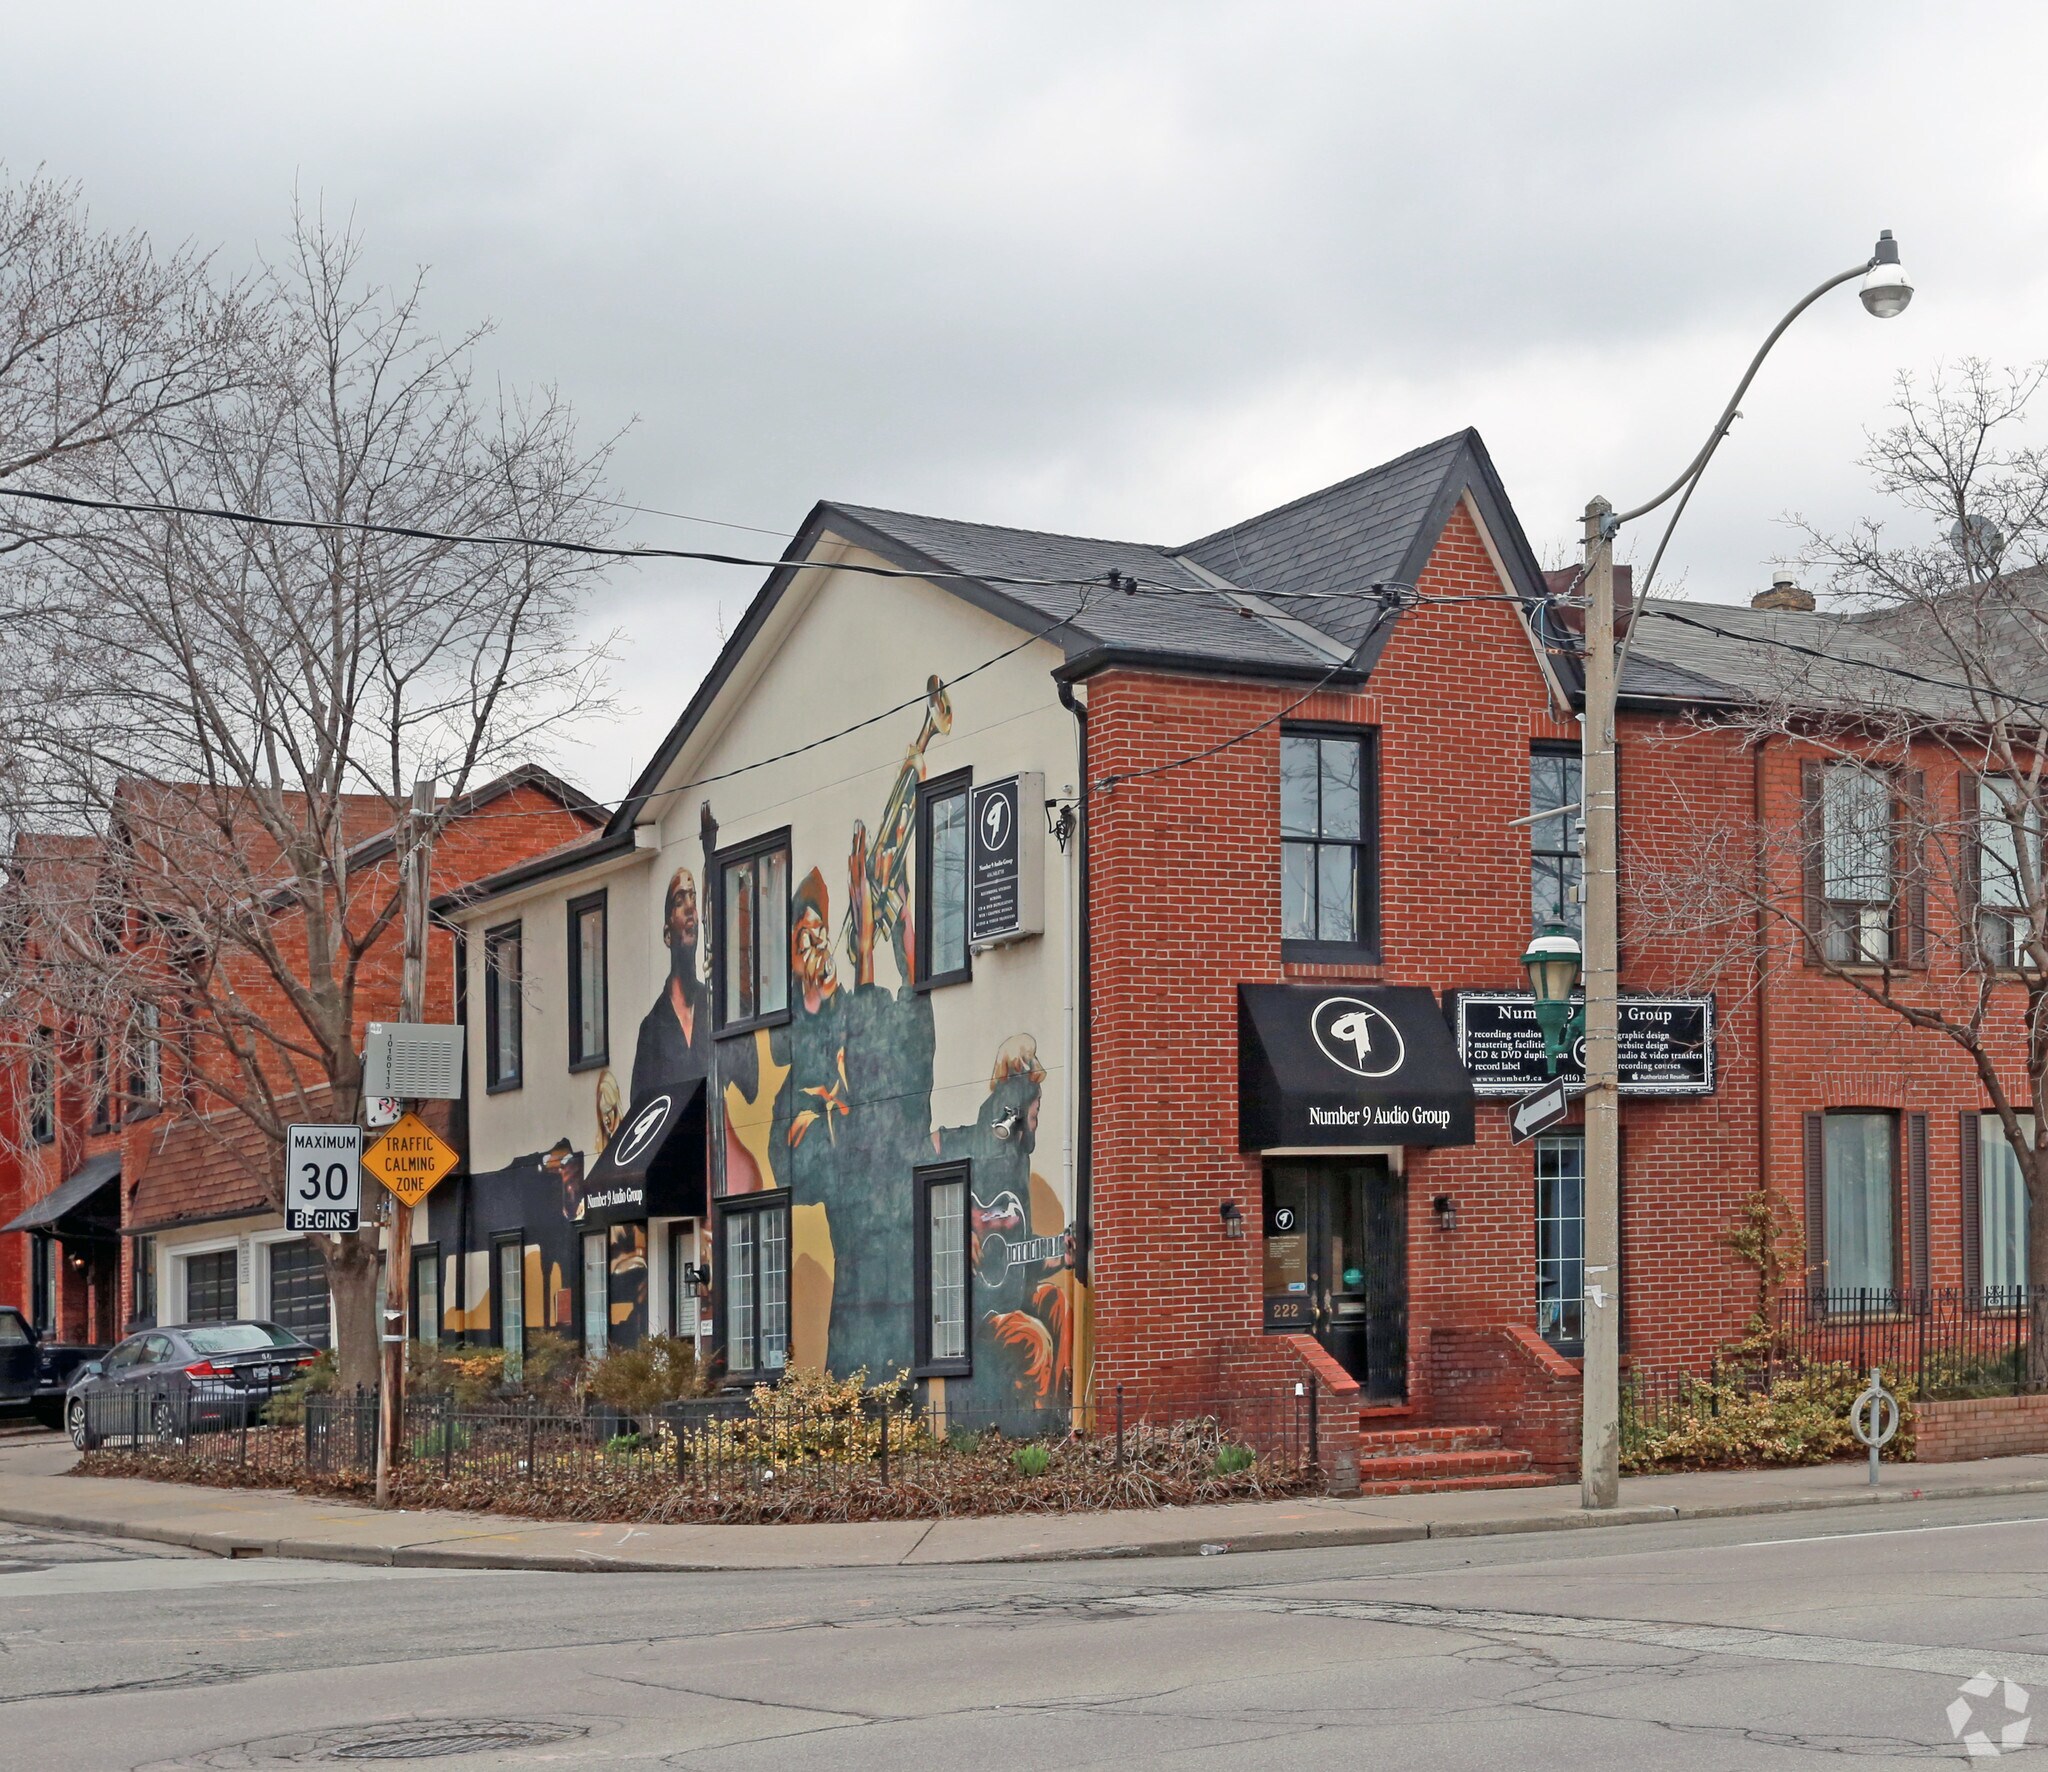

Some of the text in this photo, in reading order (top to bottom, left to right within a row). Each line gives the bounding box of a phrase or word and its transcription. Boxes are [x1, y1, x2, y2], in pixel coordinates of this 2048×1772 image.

[987, 801, 1006, 847] 9
[1498, 1006, 1537, 1019] Num
[1628, 1007, 1672, 1025] Group
[1331, 1011, 1375, 1069] 9
[1474, 1030, 1542, 1040] recording studios
[1617, 1031, 1670, 1042] graphic design
[1474, 1040, 1545, 1050] mastering facilitie
[1617, 1041, 1668, 1051] website design
[1474, 1051, 1488, 1059] CD
[1490, 1051, 1498, 1059] &
[1501, 1051, 1522, 1059] DVD
[1617, 1051, 1703, 1060] audio & video transfers
[1475, 1062, 1520, 1070] record label
[1618, 1061, 1652, 1071] recording
[1561, 1074, 1580, 1082] (416)
[1309, 1105, 1450, 1129] Number 9 Audio Group
[295, 1136, 356, 1148] MAXIMUM
[386, 1137, 433, 1151] TRAFFIC
[385, 1157, 435, 1171] CALMING
[299, 1162, 348, 1200] 30
[396, 1177, 424, 1192] ZONE
[587, 1187, 643, 1208] Number 9 Audio Group
[294, 1212, 350, 1228] BEGINS
[1273, 1304, 1298, 1318] 222
